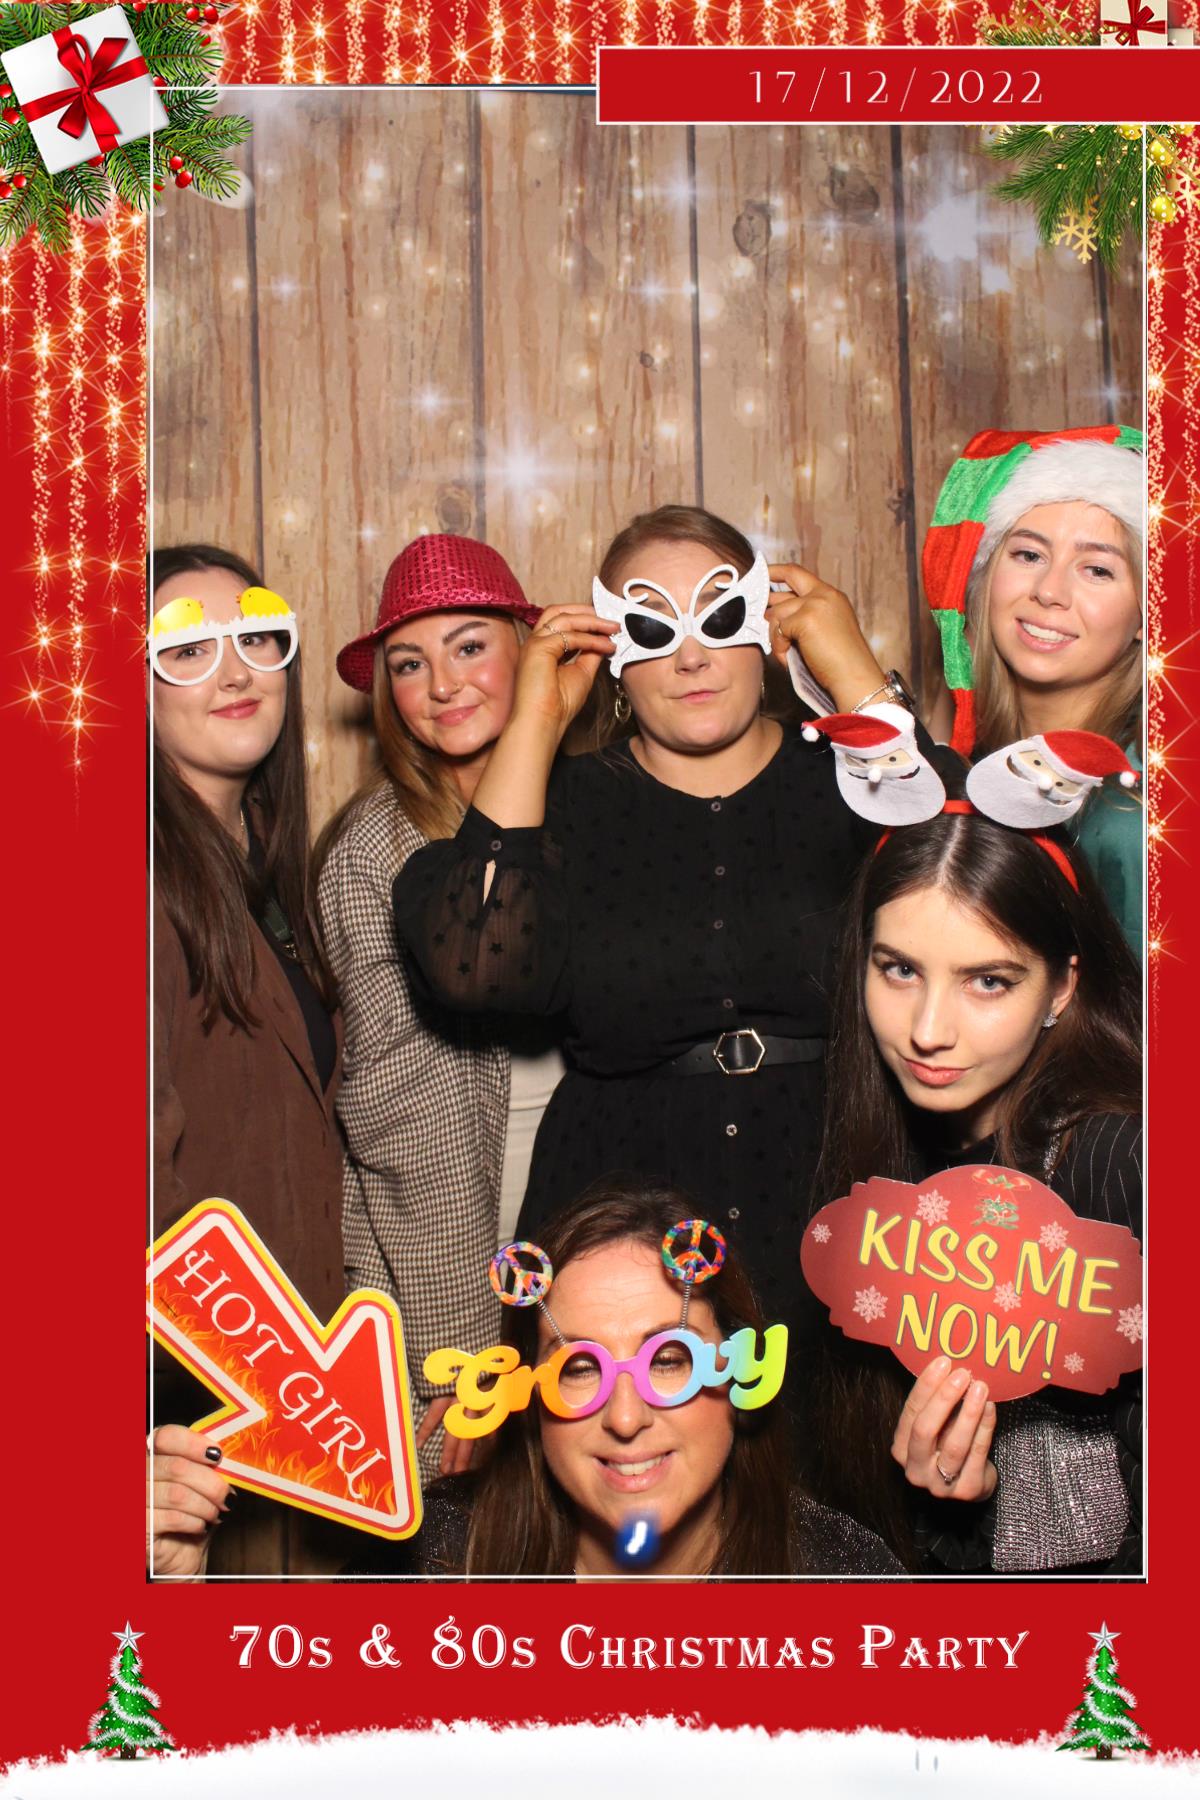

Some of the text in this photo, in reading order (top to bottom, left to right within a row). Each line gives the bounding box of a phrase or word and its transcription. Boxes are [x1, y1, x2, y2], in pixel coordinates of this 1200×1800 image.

[859, 1208, 1120, 1316] KISS ME
[174, 1249, 387, 1500] HOT GIRL
[896, 1291, 1059, 1380] NOW!
